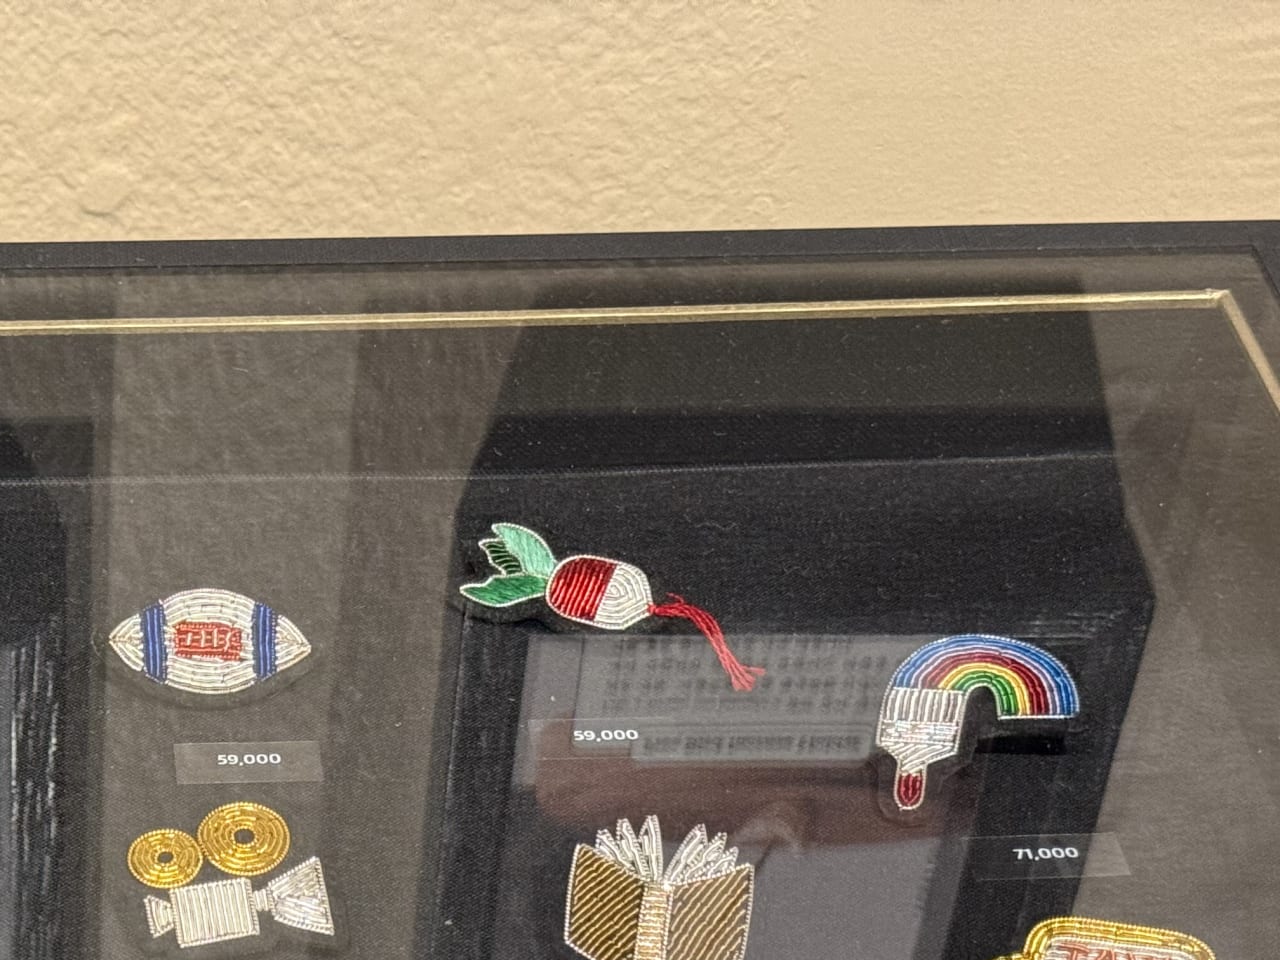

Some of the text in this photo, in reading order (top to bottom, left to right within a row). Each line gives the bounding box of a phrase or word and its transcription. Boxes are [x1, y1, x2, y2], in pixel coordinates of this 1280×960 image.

[573, 728, 639, 743] 59,000
[217, 752, 282, 766] 59,000
[1012, 847, 1079, 861] 71,000
